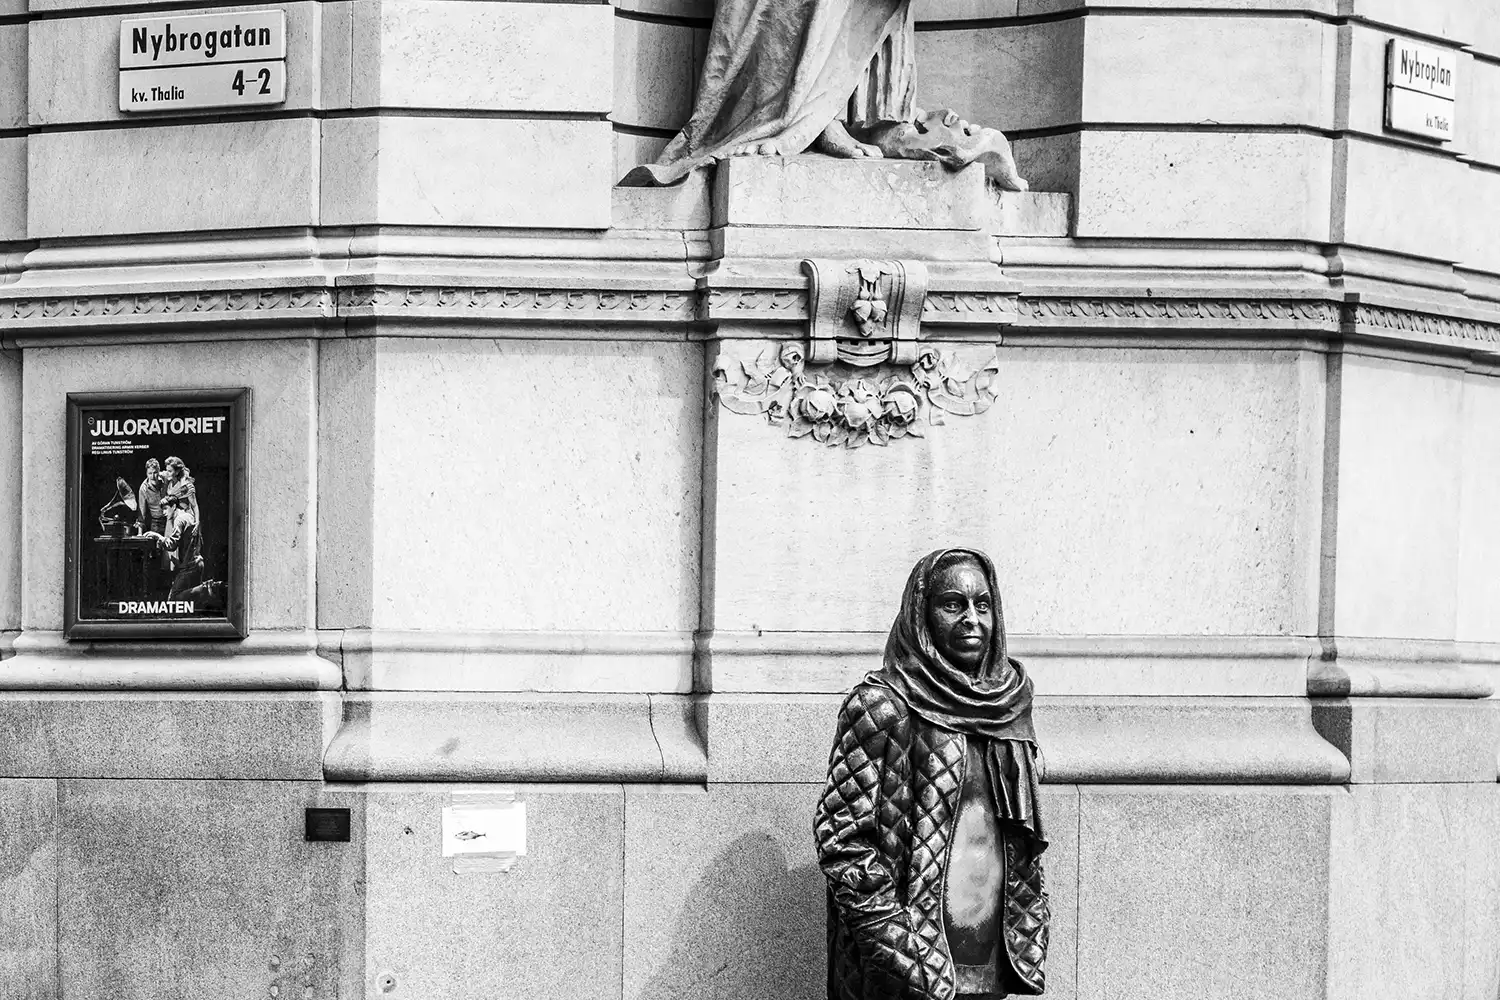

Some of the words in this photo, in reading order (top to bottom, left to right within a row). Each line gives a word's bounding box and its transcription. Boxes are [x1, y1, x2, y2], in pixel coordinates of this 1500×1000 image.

[132, 23, 271, 61] Nybrogatan
[1400, 48, 1451, 89] Nybroplan
[131, 88, 148, 103] kv.
[151, 85, 185, 101] Thalia
[90, 416, 225, 437] JULORATORIET
[118, 600, 195, 615] DRAMATEN
